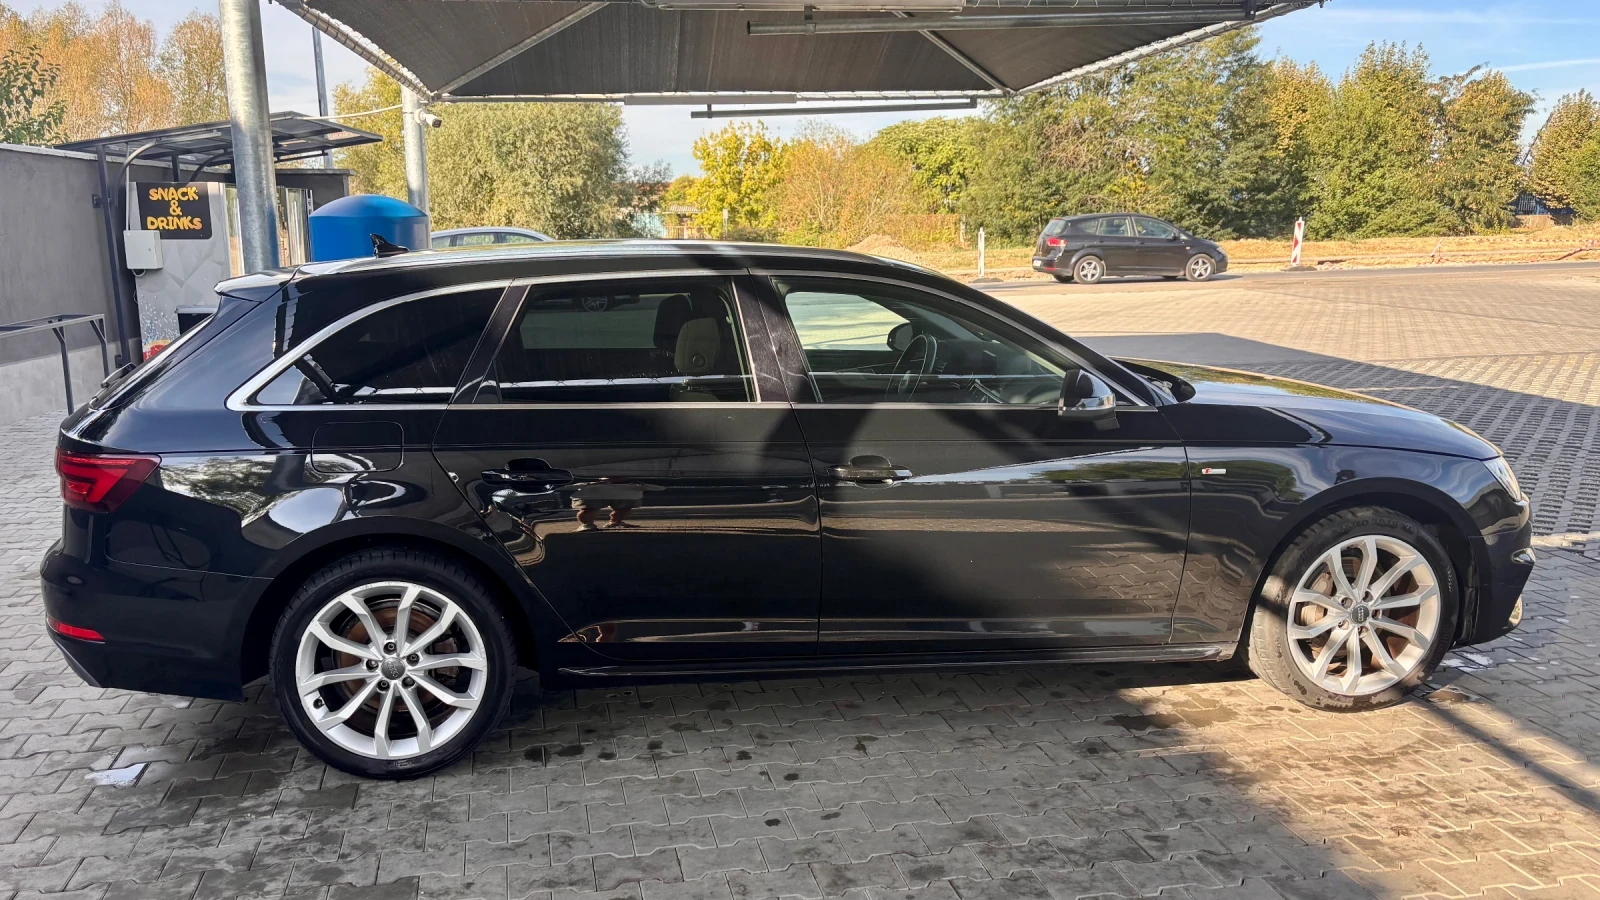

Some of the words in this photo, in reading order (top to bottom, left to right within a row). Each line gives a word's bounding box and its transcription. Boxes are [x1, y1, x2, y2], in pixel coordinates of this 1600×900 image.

[148, 186, 199, 201] SNACK
[169, 199, 183, 216] &
[146, 215, 203, 230] DRINKS
